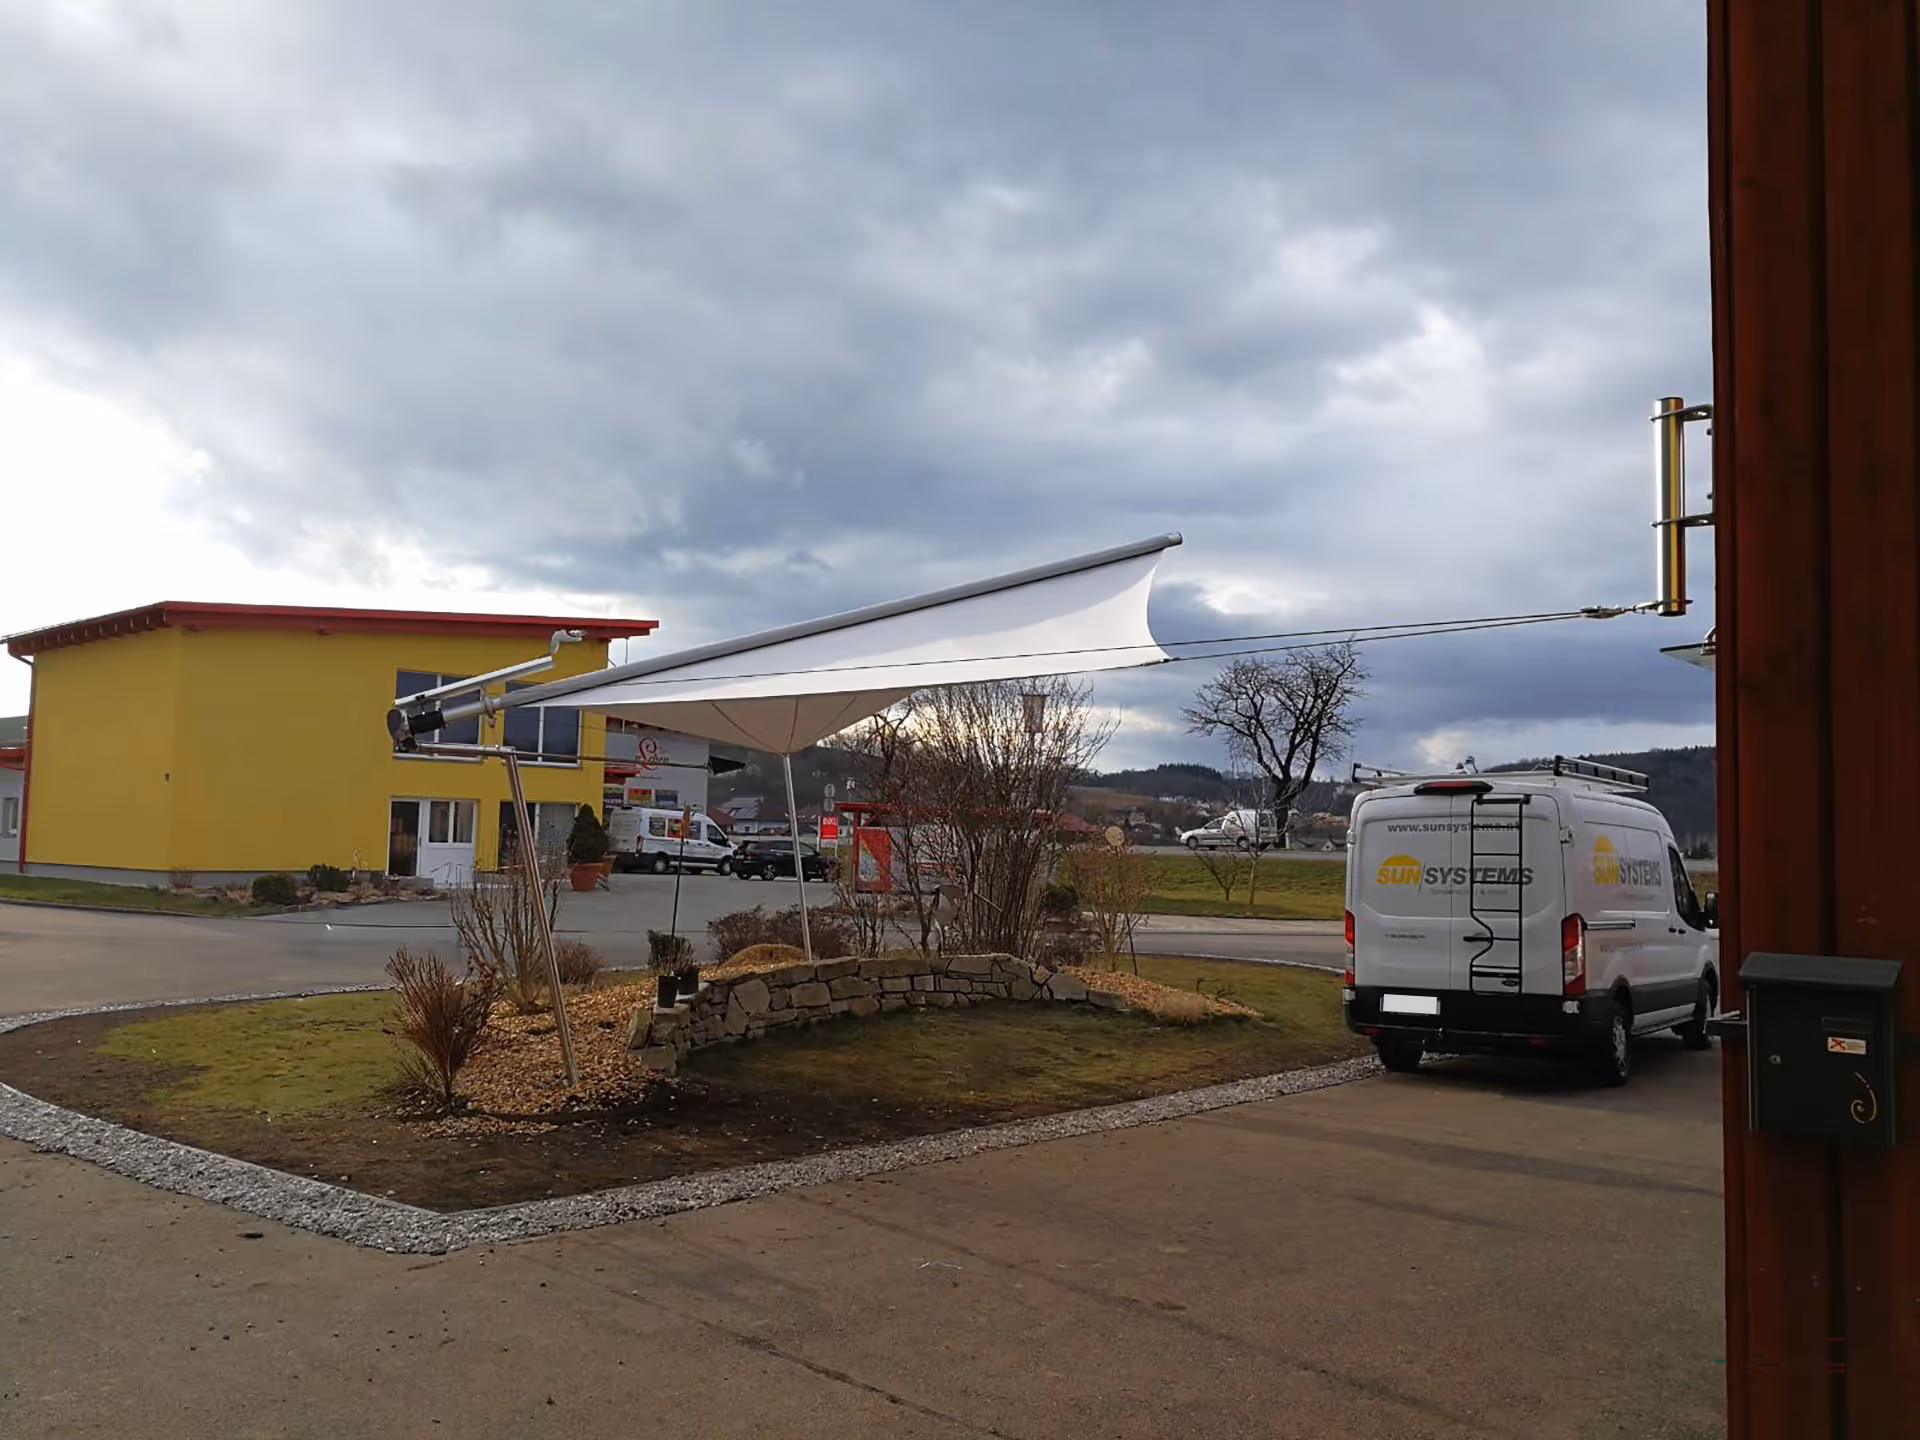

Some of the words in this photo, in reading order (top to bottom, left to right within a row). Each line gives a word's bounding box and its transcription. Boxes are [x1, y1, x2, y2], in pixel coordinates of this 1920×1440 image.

[1376, 866, 1422, 884] SUN
[1424, 867, 1534, 886] SYSTEMS
[1620, 856, 1662, 887] SYSTEMS
